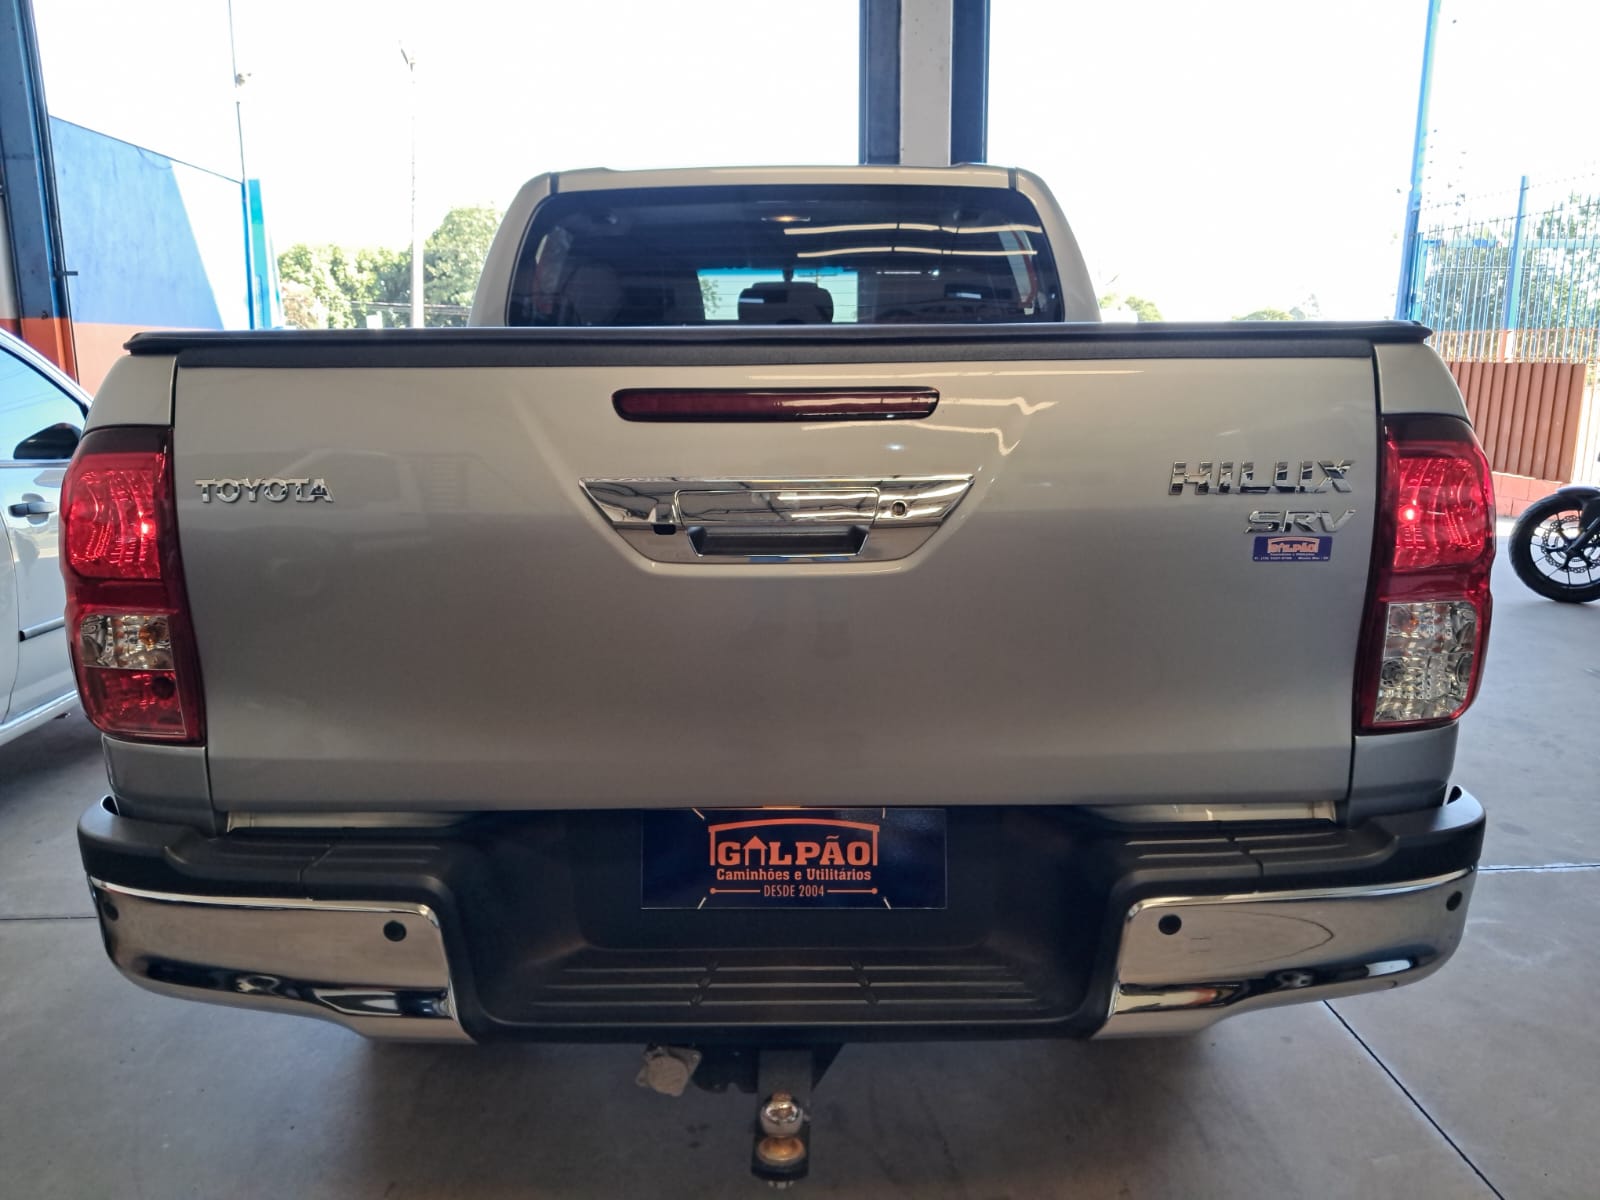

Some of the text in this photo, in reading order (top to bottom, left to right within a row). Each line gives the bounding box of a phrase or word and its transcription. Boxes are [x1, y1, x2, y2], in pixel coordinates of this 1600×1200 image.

[195, 477, 334, 503] TOYOTA
[1168, 460, 1354, 495] HILUX
[1244, 509, 1356, 533] SRV
[717, 835, 870, 866] GALPÃO
[716, 868, 872, 881] Caminhões e Utilitários
[764, 885, 825, 897] DESDE 2004
